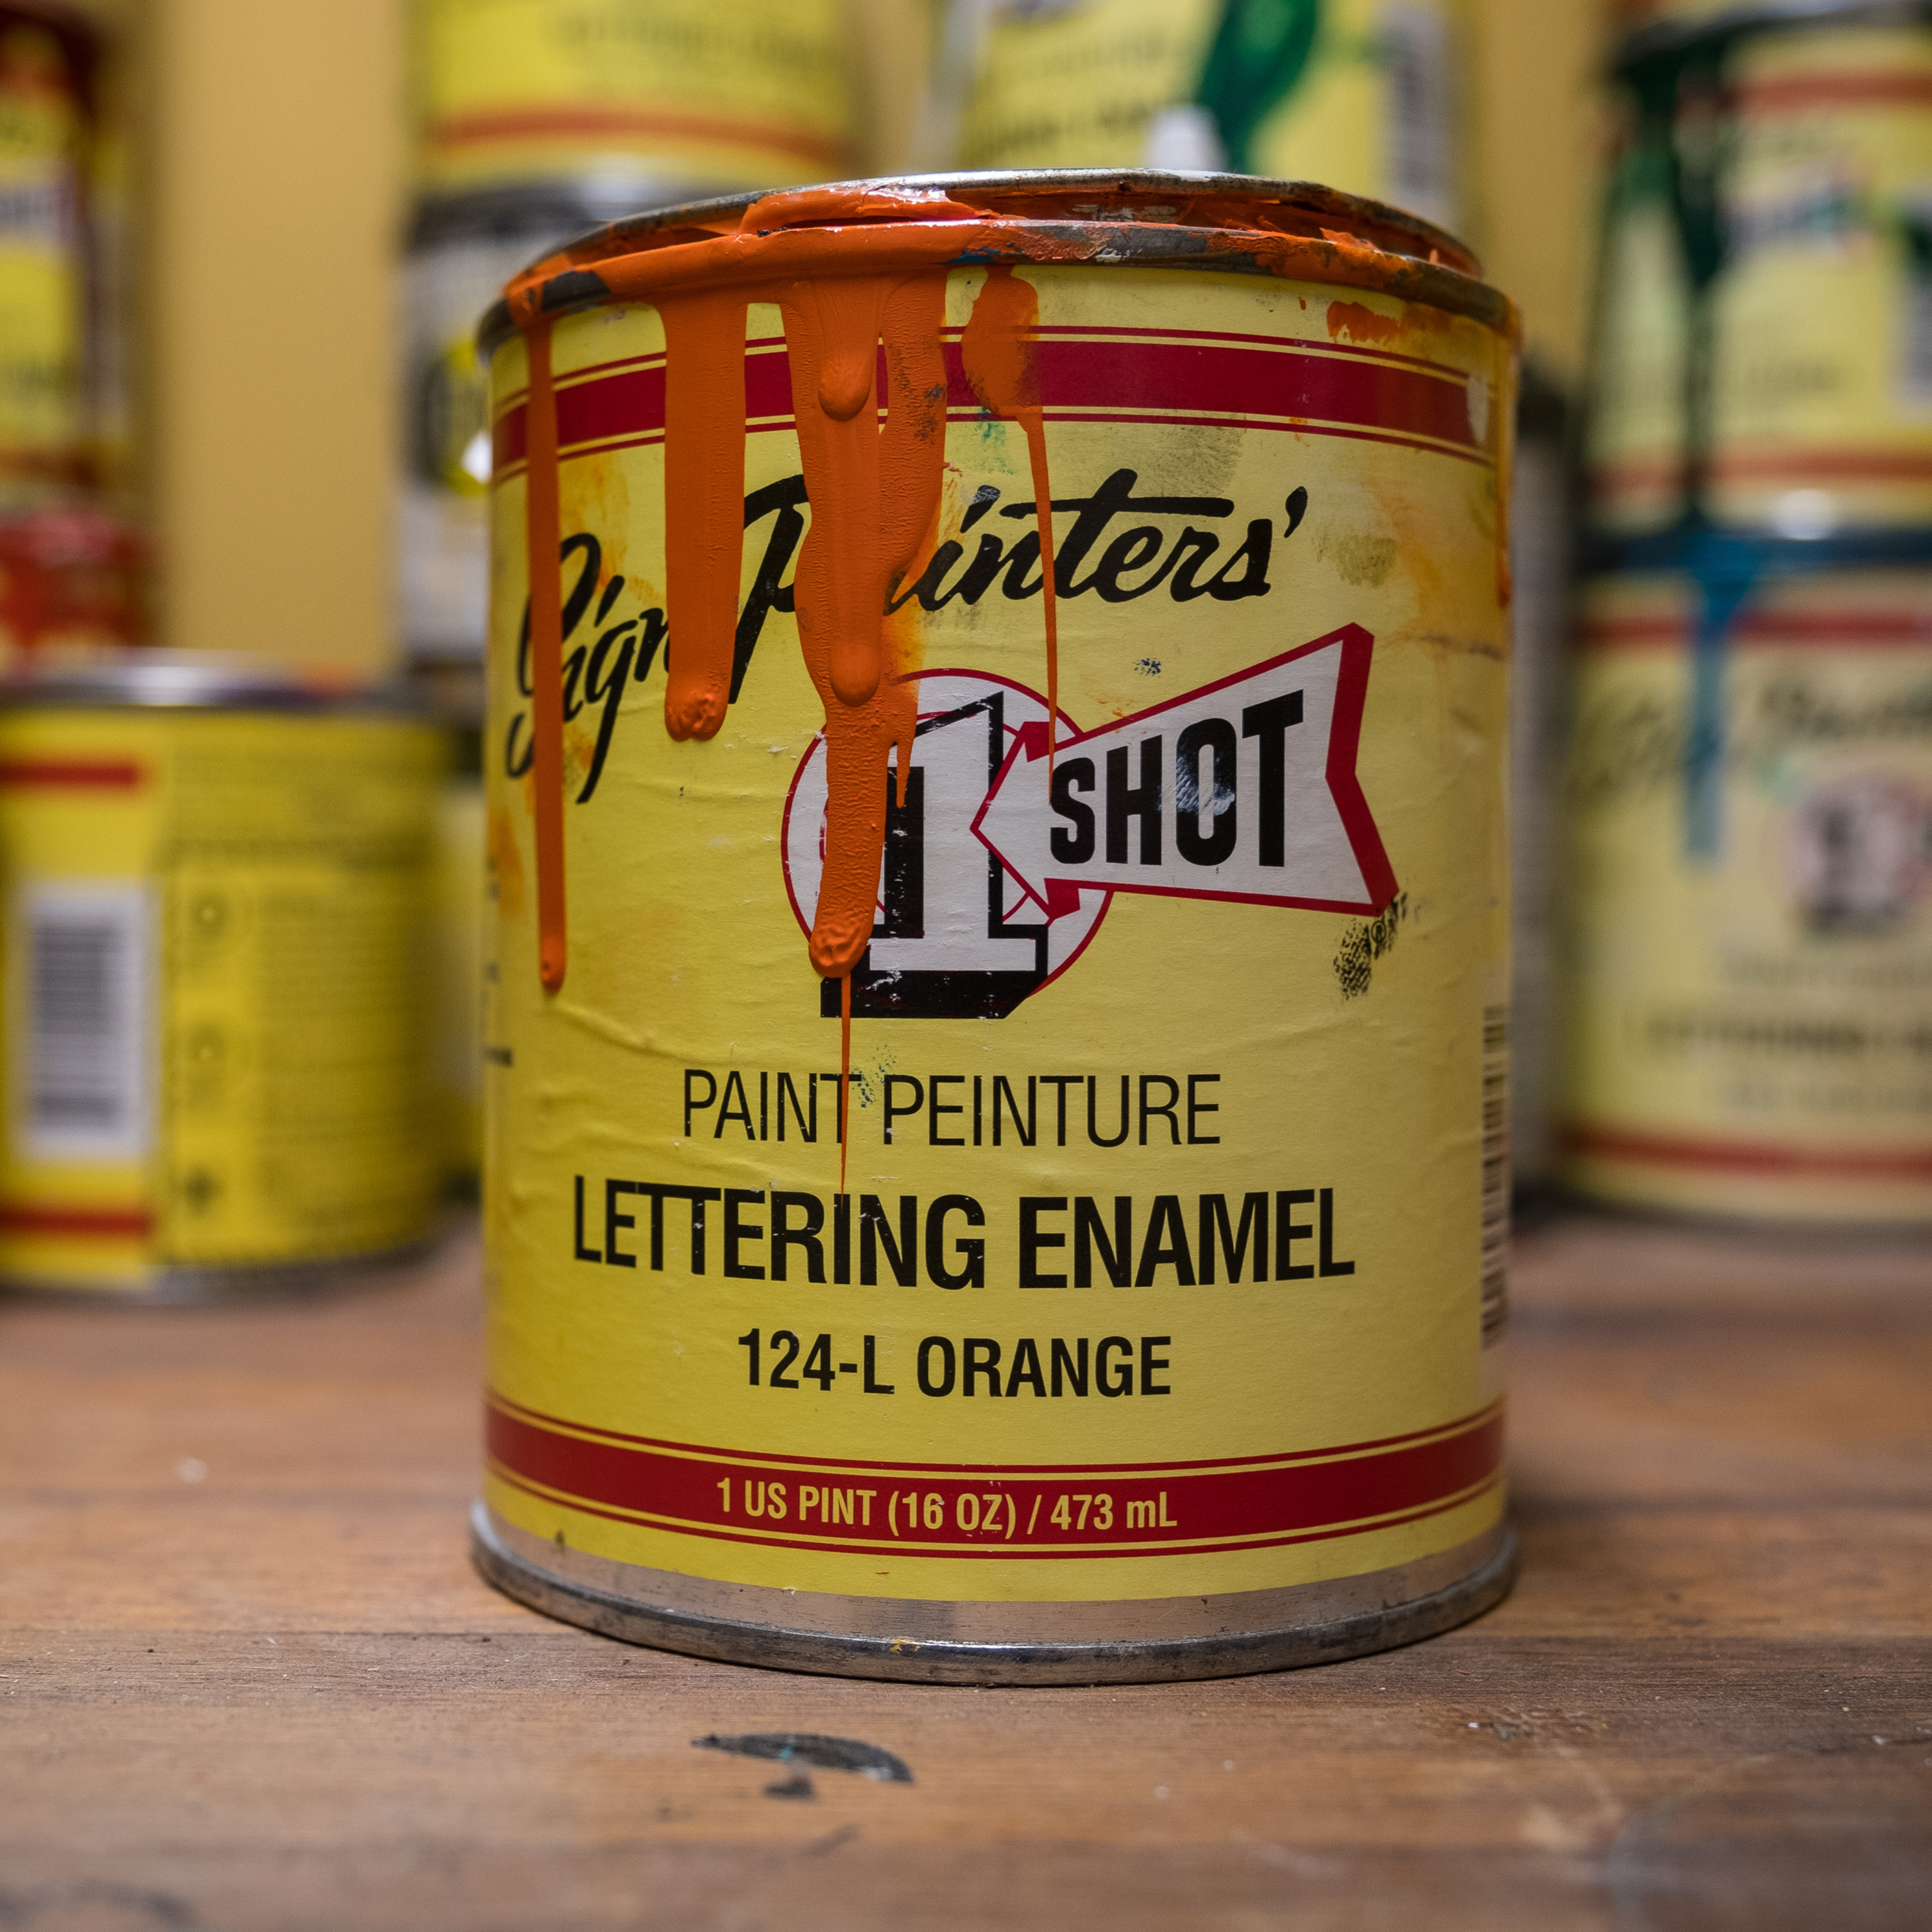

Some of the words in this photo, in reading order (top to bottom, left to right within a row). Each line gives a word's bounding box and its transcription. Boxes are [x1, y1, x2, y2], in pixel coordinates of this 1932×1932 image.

[820, 690, 1048, 1019] 1
[1050, 689, 1304, 867] SHOT
[683, 1068, 863, 1144] PAINT
[883, 1074, 1221, 1148] PEINTURE
[574, 1175, 986, 1290] LETTERING
[1018, 1187, 1355, 1289] ENAMEL
[738, 1327, 895, 1394] 124-L
[916, 1335, 1171, 1397] ORANGE
[716, 1477, 731, 1513] 1
[744, 1481, 788, 1519] US
[799, 1486, 876, 1526] PINT
[889, 1490, 943, 1536] (16
[956, 1493, 1017, 1539] OZ)
[1027, 1495, 1042, 1534] /
[1050, 1493, 1114, 1530] 473
[1126, 1491, 1178, 1528] mL
